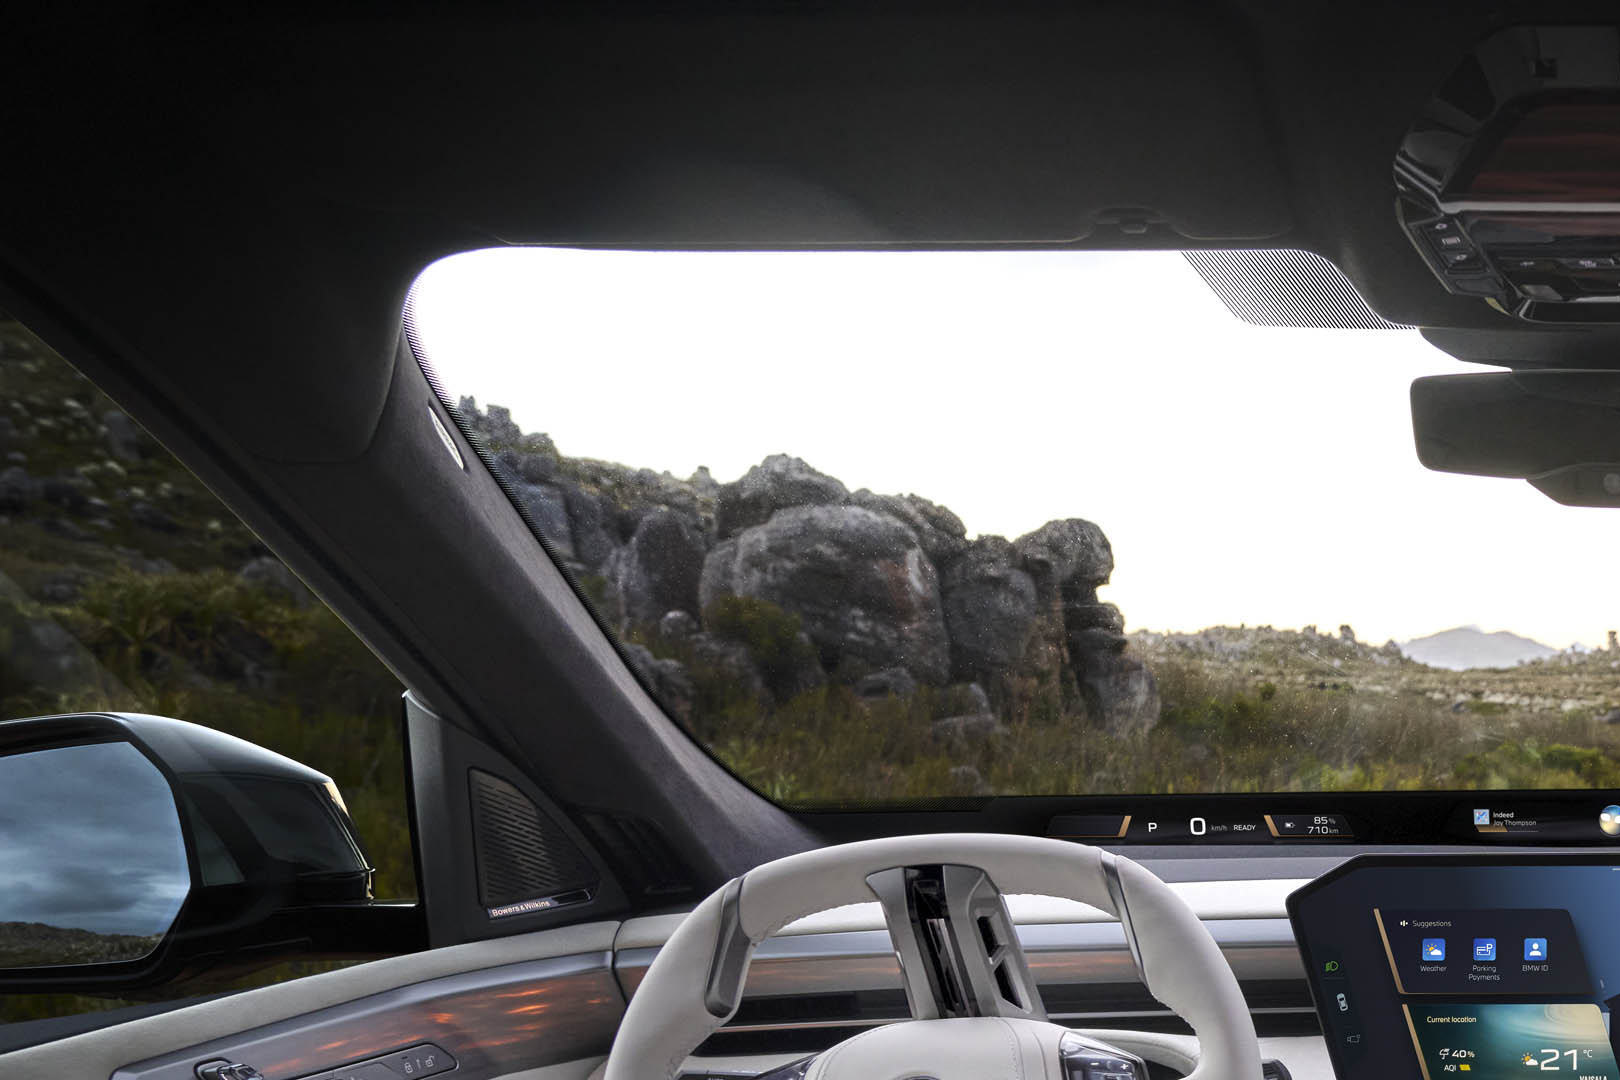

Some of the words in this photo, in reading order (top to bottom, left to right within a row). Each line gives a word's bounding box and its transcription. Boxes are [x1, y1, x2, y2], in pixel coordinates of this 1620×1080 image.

[1148, 822, 1158, 832] P
[1190, 817, 1206, 835] 0
[492, 904, 520, 917] Bowers
[524, 900, 550, 910] Wilkins
[1412, 920, 1452, 928] Suggestions
[1472, 965, 1497, 973] Parking
[1468, 973, 1500, 981] Payments
[1540, 1049, 1578, 1071] 21
[1444, 1064, 1457, 1072] AQI
